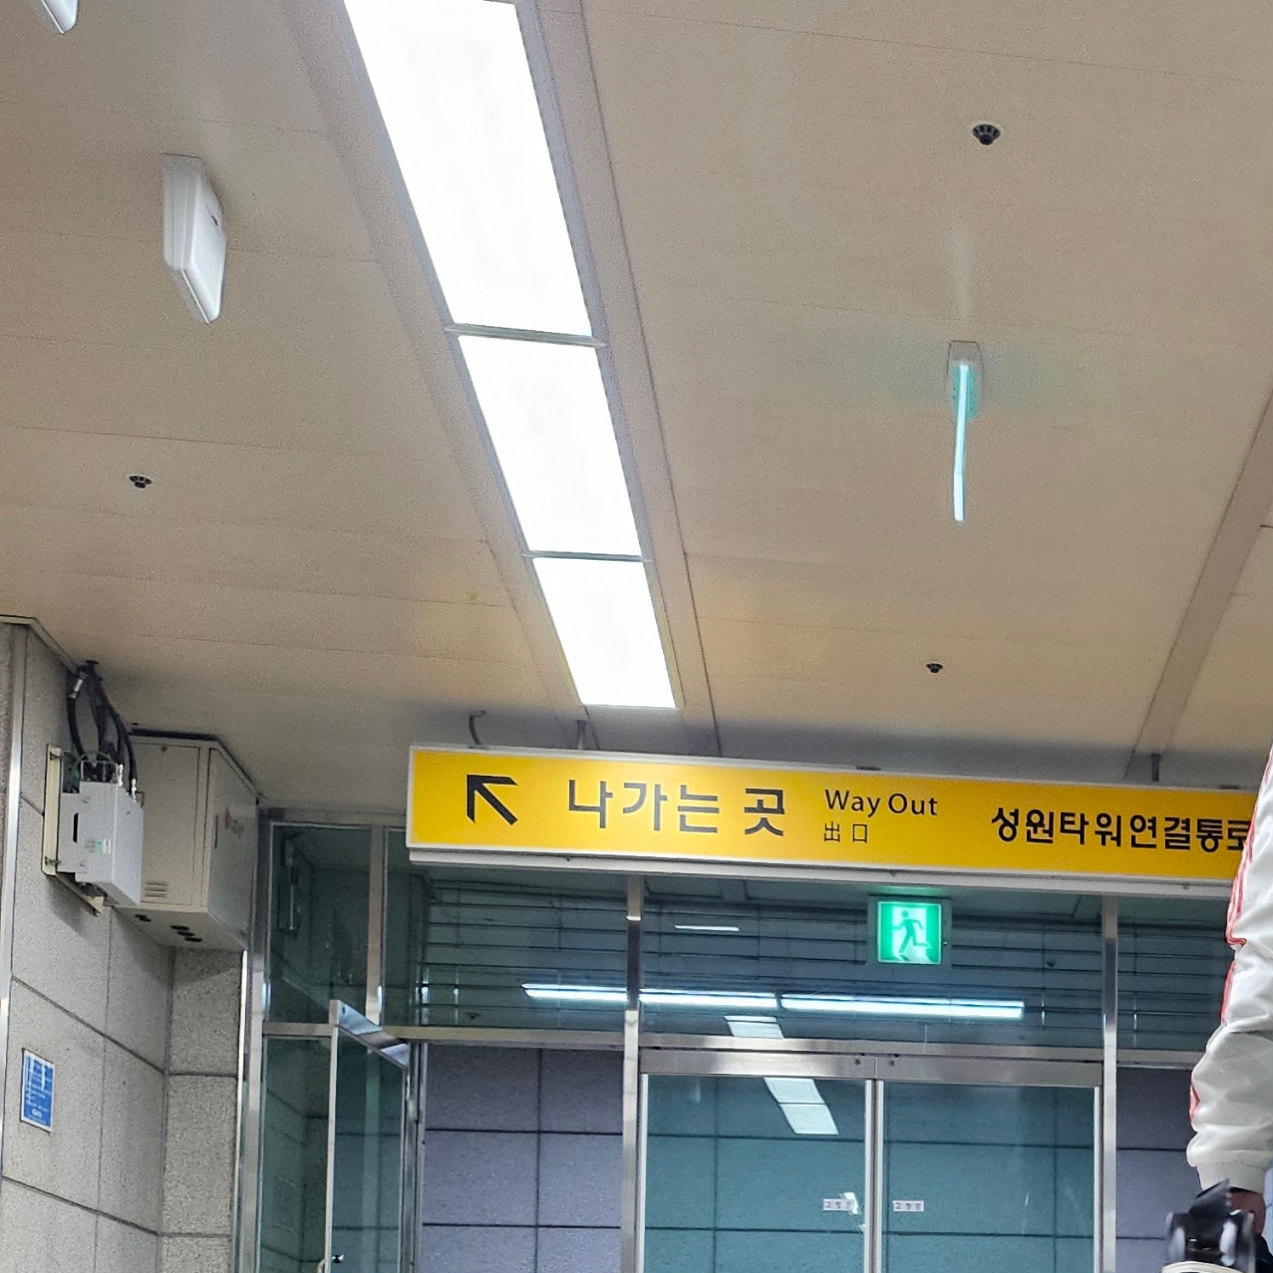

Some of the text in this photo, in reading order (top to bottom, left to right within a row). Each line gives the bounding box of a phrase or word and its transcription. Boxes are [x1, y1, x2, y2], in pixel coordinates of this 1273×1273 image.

[569, 779, 785, 836] 나가는 곳
[825, 789, 938, 818] Way Out
[824, 821, 868, 843] 出口
